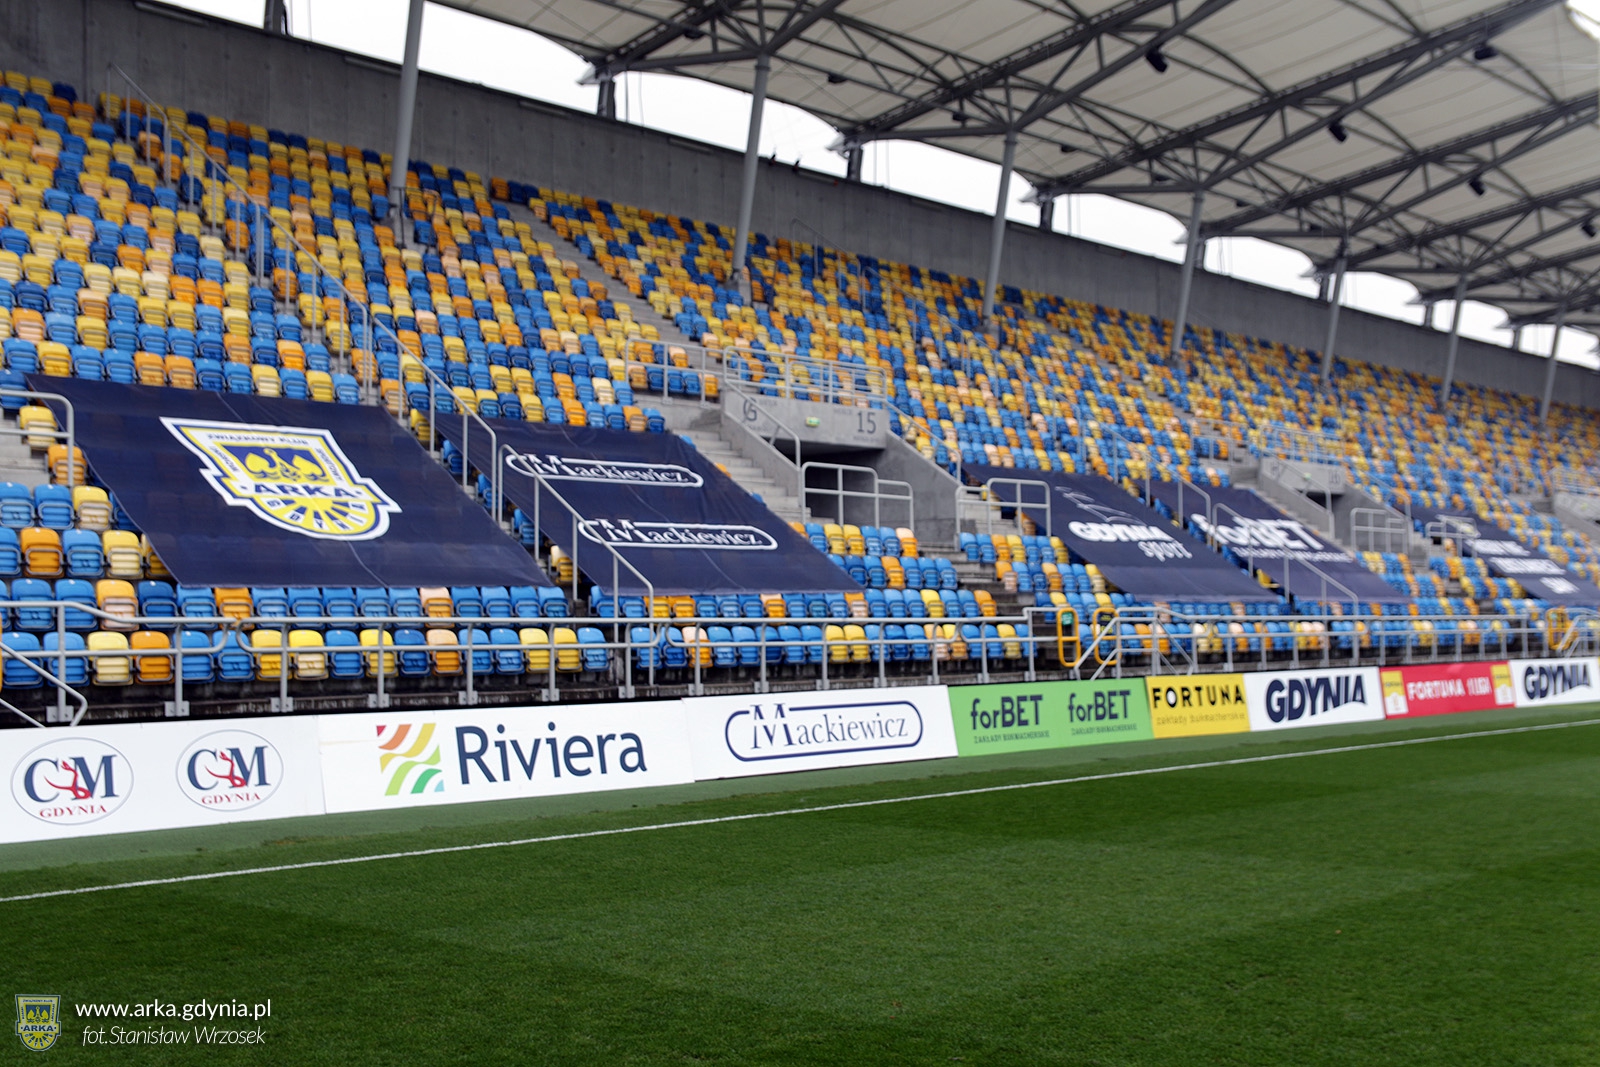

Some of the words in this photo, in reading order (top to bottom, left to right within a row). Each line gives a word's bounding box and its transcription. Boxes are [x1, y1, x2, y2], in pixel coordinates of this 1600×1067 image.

[857, 411, 877, 434] 15
[519, 453, 690, 483] Mackiewicz
[254, 483, 356, 498] ARKA
[596, 518, 764, 546] Mackiewicz
[1068, 521, 1176, 543] GDYNIA
[1137, 540, 1193, 563] sport
[1406, 679, 1466, 701] FORTUNA
[1524, 664, 1592, 700] GDYNIA
[1067, 690, 1132, 723] forBET
[1152, 685, 1246, 709] FORTUNA
[1265, 675, 1368, 723] GDYNIA
[970, 694, 1043, 731] forBET
[750, 703, 909, 750] Mackiewicz
[455, 721, 648, 785] Riviera
[39, 804, 108, 819] GDYNIA
[201, 792, 262, 806] GDYNIA
